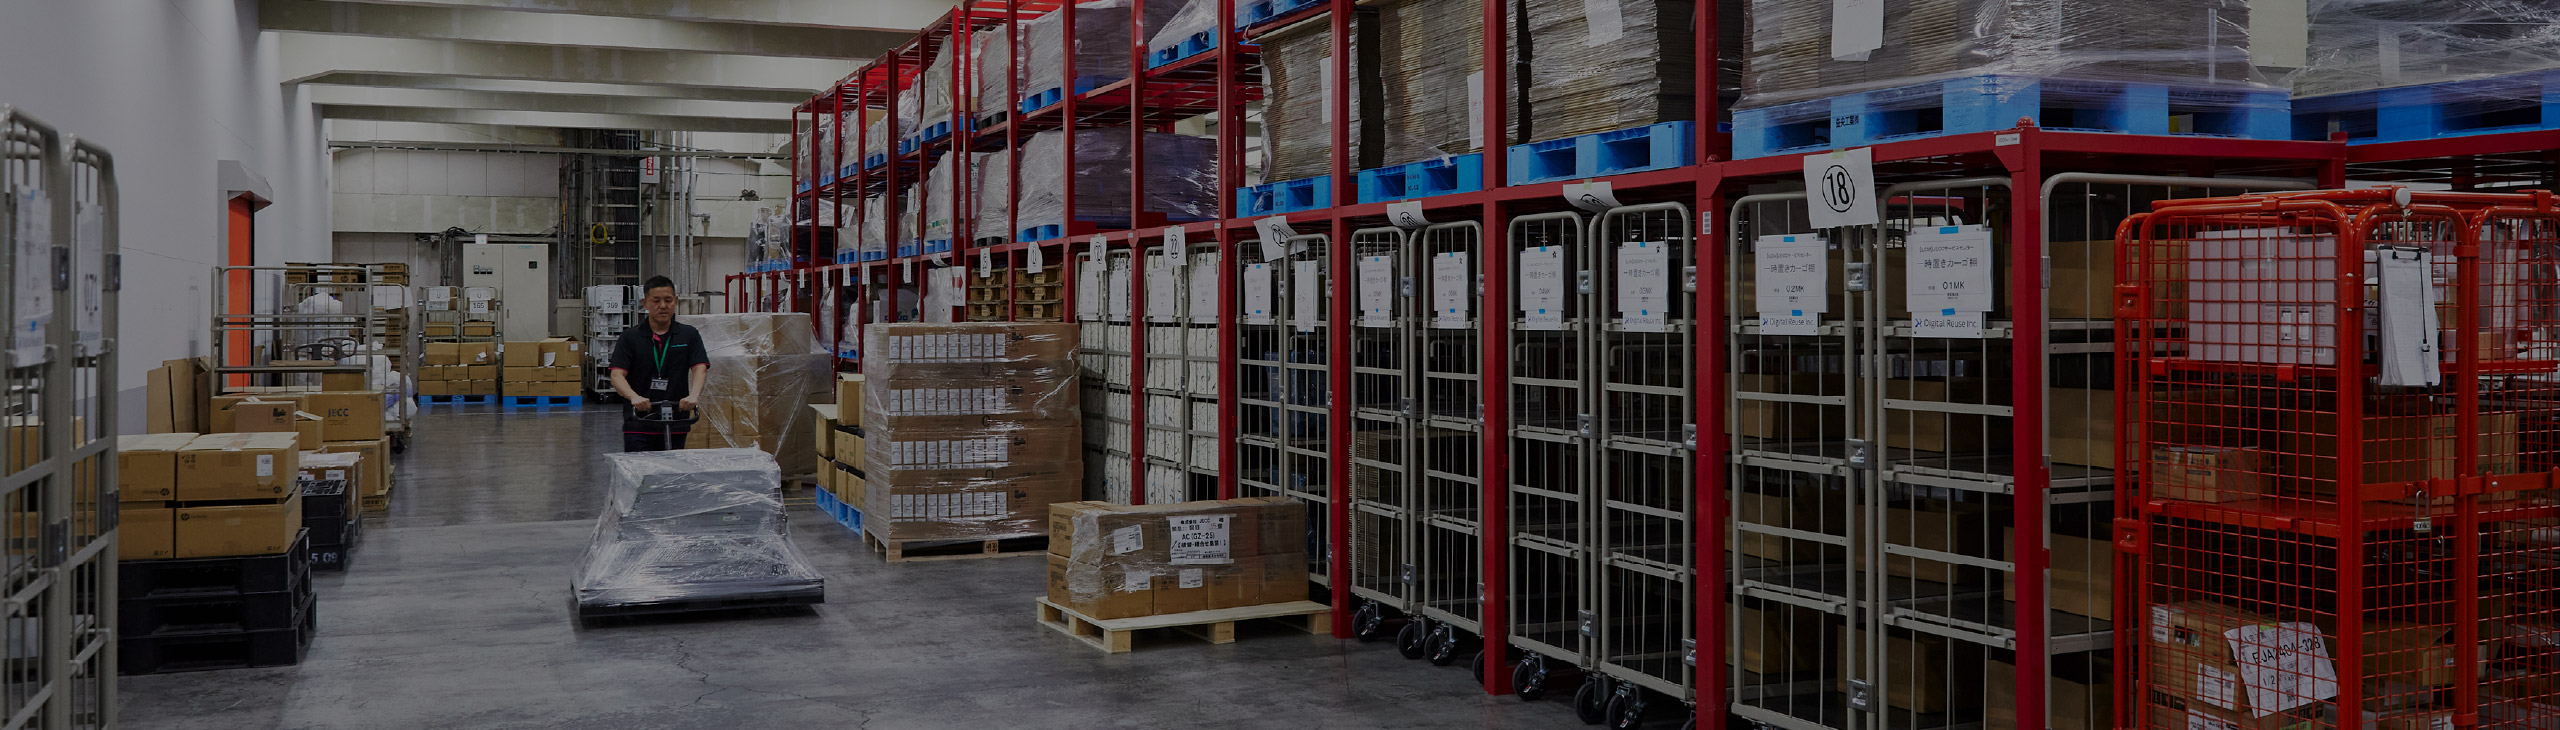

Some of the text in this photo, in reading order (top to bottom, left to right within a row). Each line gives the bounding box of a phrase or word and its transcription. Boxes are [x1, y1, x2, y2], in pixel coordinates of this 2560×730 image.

[1825, 169, 1852, 209] 18
[1785, 285, 1805, 293] 02MK
[1942, 281, 1965, 290] 01MK
[1769, 317, 1788, 328] Digital
[1788, 318, 1805, 326] Reuse
[1924, 318, 1979, 329] Digital Reuse Inc.
[328, 408, 349, 418] JECC
